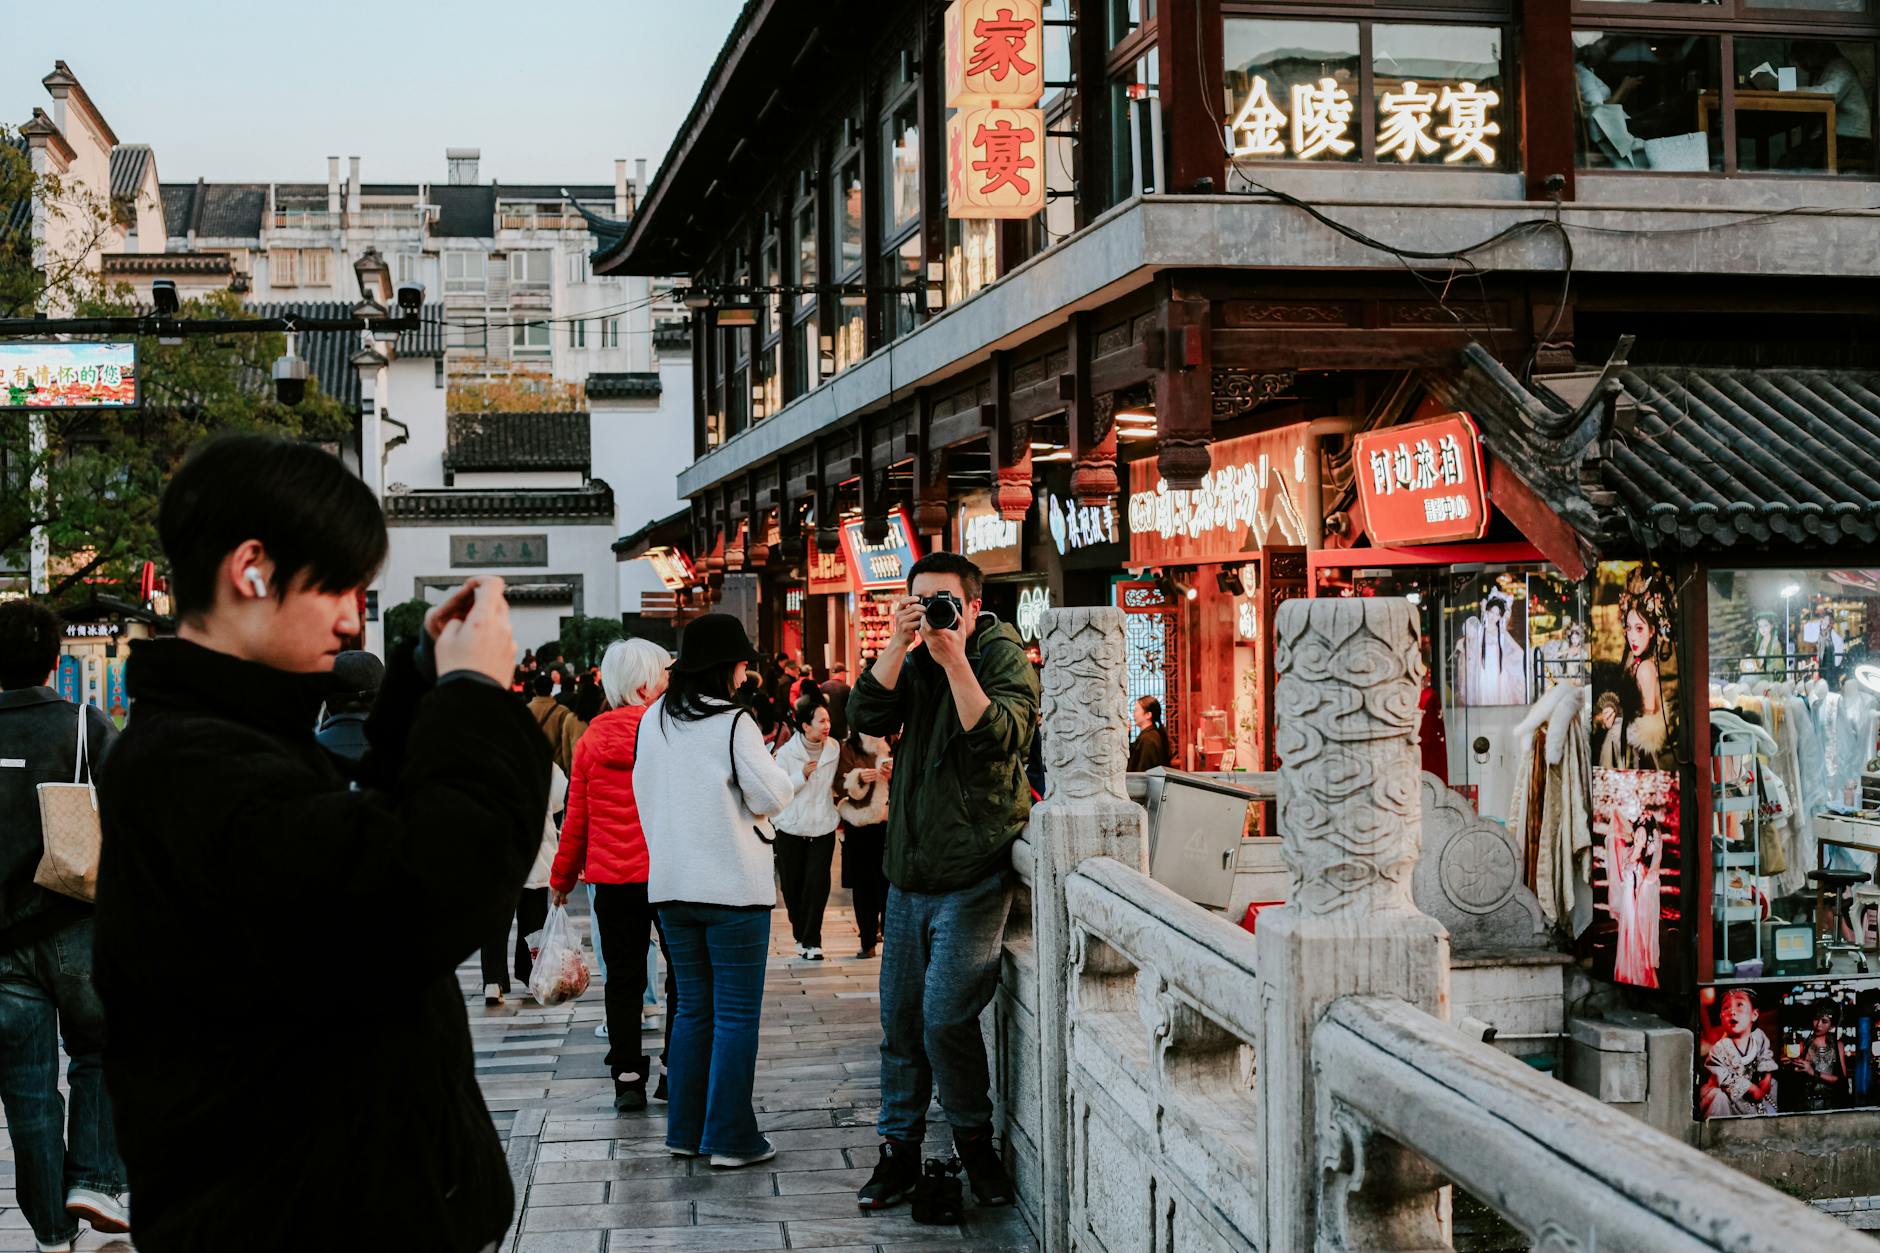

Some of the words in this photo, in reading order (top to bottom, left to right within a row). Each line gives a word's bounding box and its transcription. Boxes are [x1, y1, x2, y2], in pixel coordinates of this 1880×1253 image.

[967, 9, 1036, 195] 家宴
[1232, 75, 1500, 164] 金陵家宴
